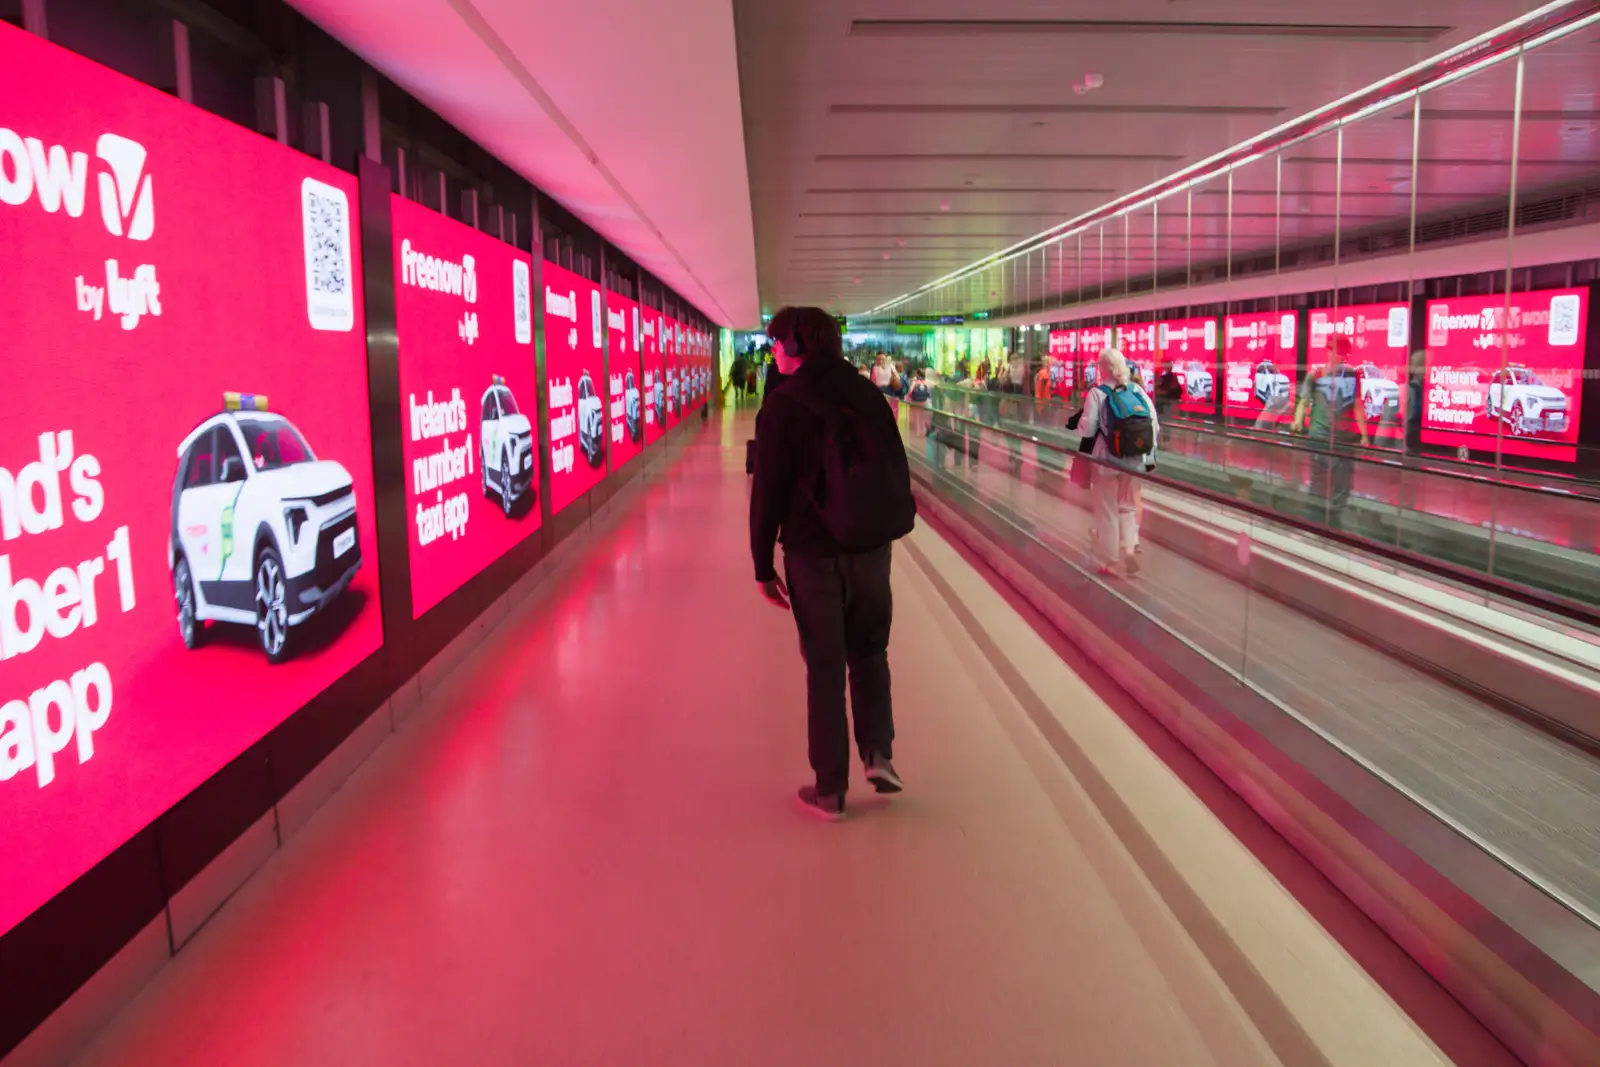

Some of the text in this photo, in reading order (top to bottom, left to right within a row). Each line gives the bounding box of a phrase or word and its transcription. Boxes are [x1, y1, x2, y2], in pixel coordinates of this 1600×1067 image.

[75, 258, 162, 330] by lyft
[1430, 365, 1479, 385] Different
[410, 388, 467, 441] Ireland's
[1428, 403, 1474, 424] Freenow
[413, 433, 474, 495] number 1
[416, 490, 469, 546] taxi app
[106, 525, 136, 613] 1
[0, 662, 113, 789] app
